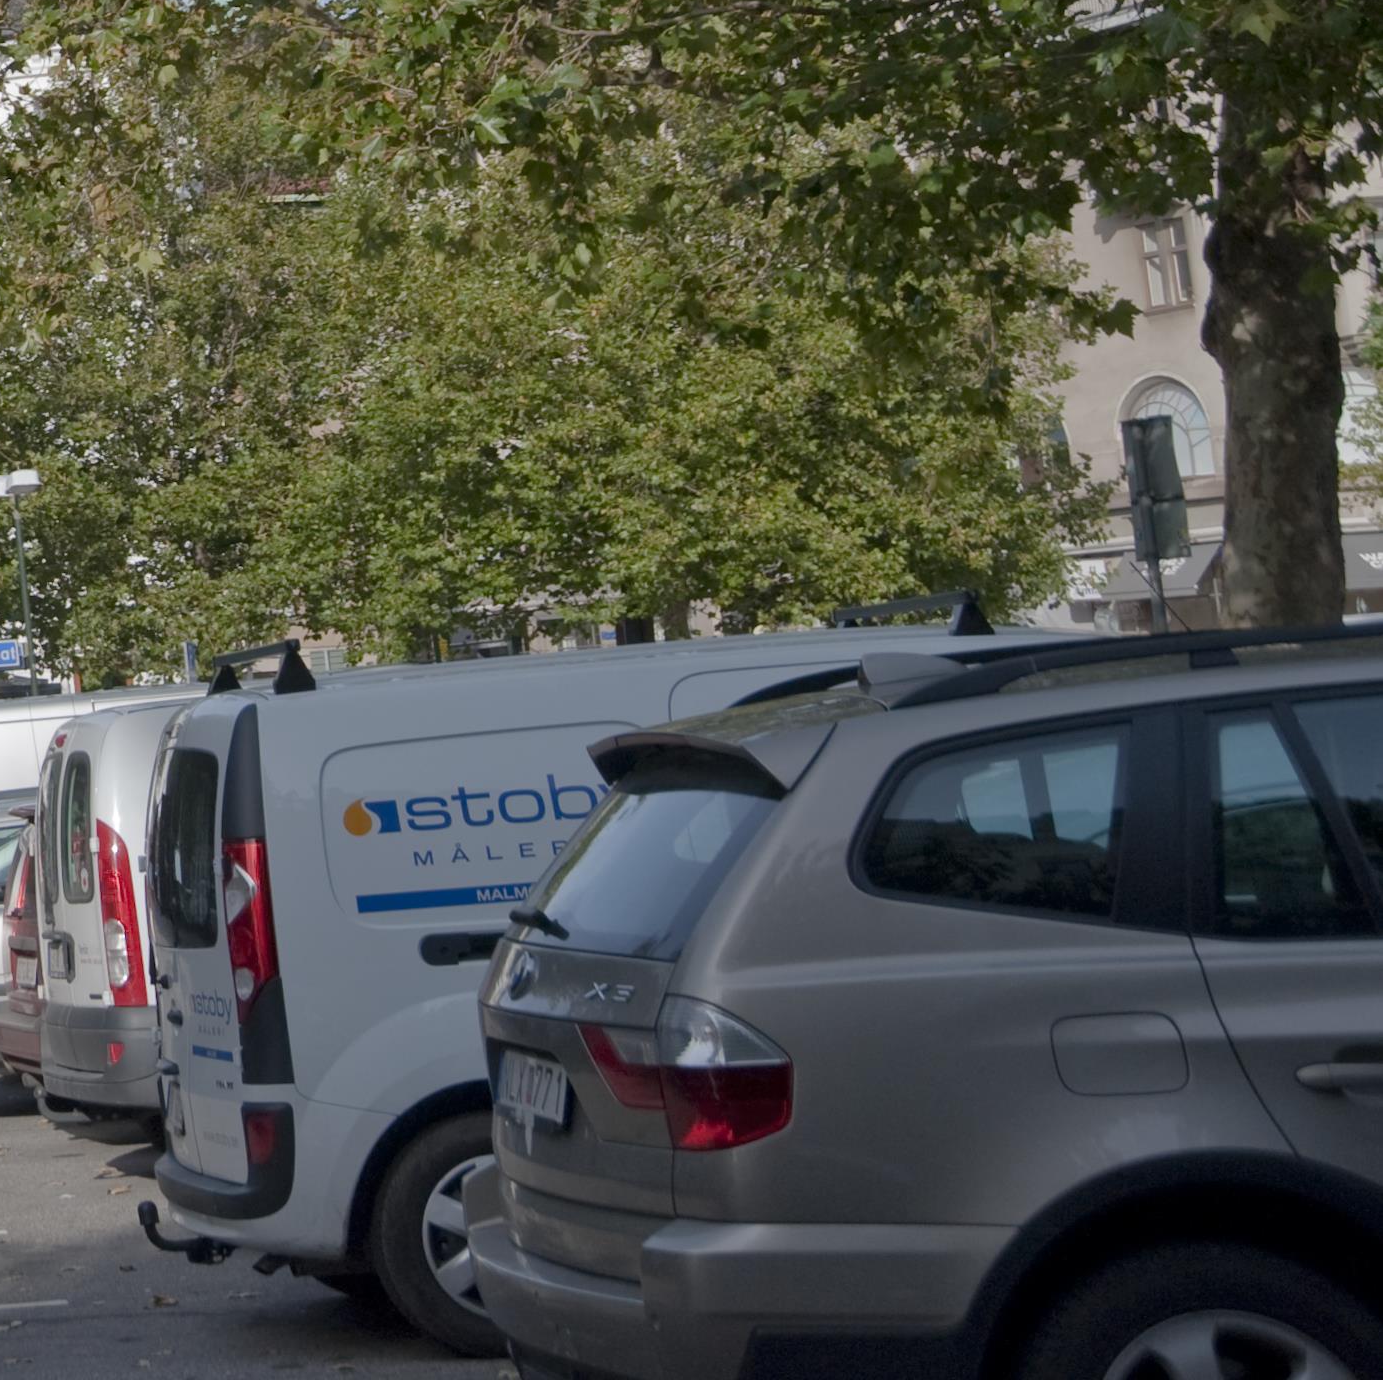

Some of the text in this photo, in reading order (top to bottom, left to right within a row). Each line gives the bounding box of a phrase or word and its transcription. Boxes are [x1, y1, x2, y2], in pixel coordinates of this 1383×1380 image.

[405, 774, 612, 832] stob
[476, 884, 531, 903] MALM
[585, 981, 635, 1002] X3
